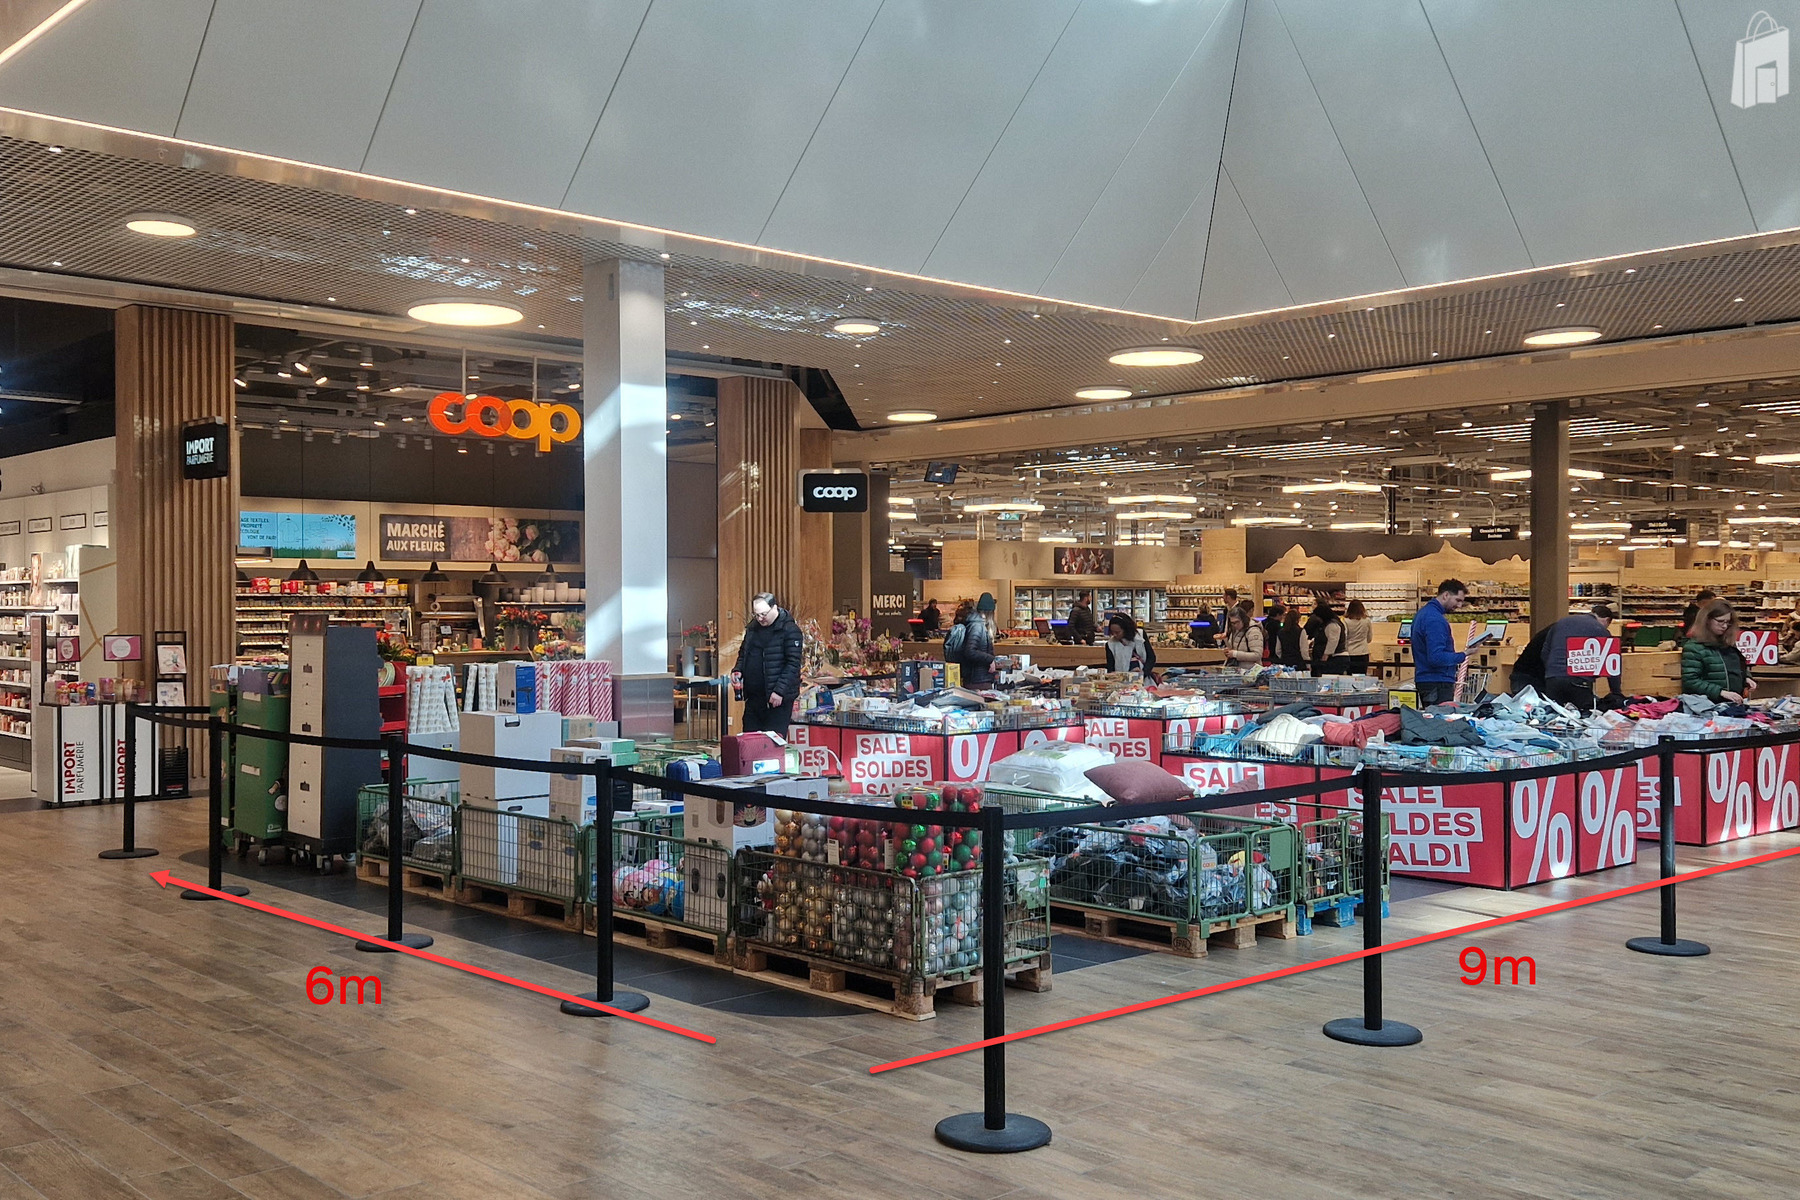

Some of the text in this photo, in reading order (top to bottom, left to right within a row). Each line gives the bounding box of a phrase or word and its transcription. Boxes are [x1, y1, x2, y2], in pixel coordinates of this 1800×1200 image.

[428, 392, 581, 452] coop
[186, 437, 214, 454] IMPORT
[813, 487, 857, 501] coop
[387, 520, 445, 538] MARCHÉ
[386, 540, 445, 552] AUX FLEURS
[873, 595, 906, 608] MERCI
[860, 736, 908, 755] SALE
[64, 742, 75, 794] IMPORT
[76, 741, 84, 793] PARFUMERIE
[855, 760, 928, 778] SOLDES
[1390, 843, 1462, 866] ALDI
